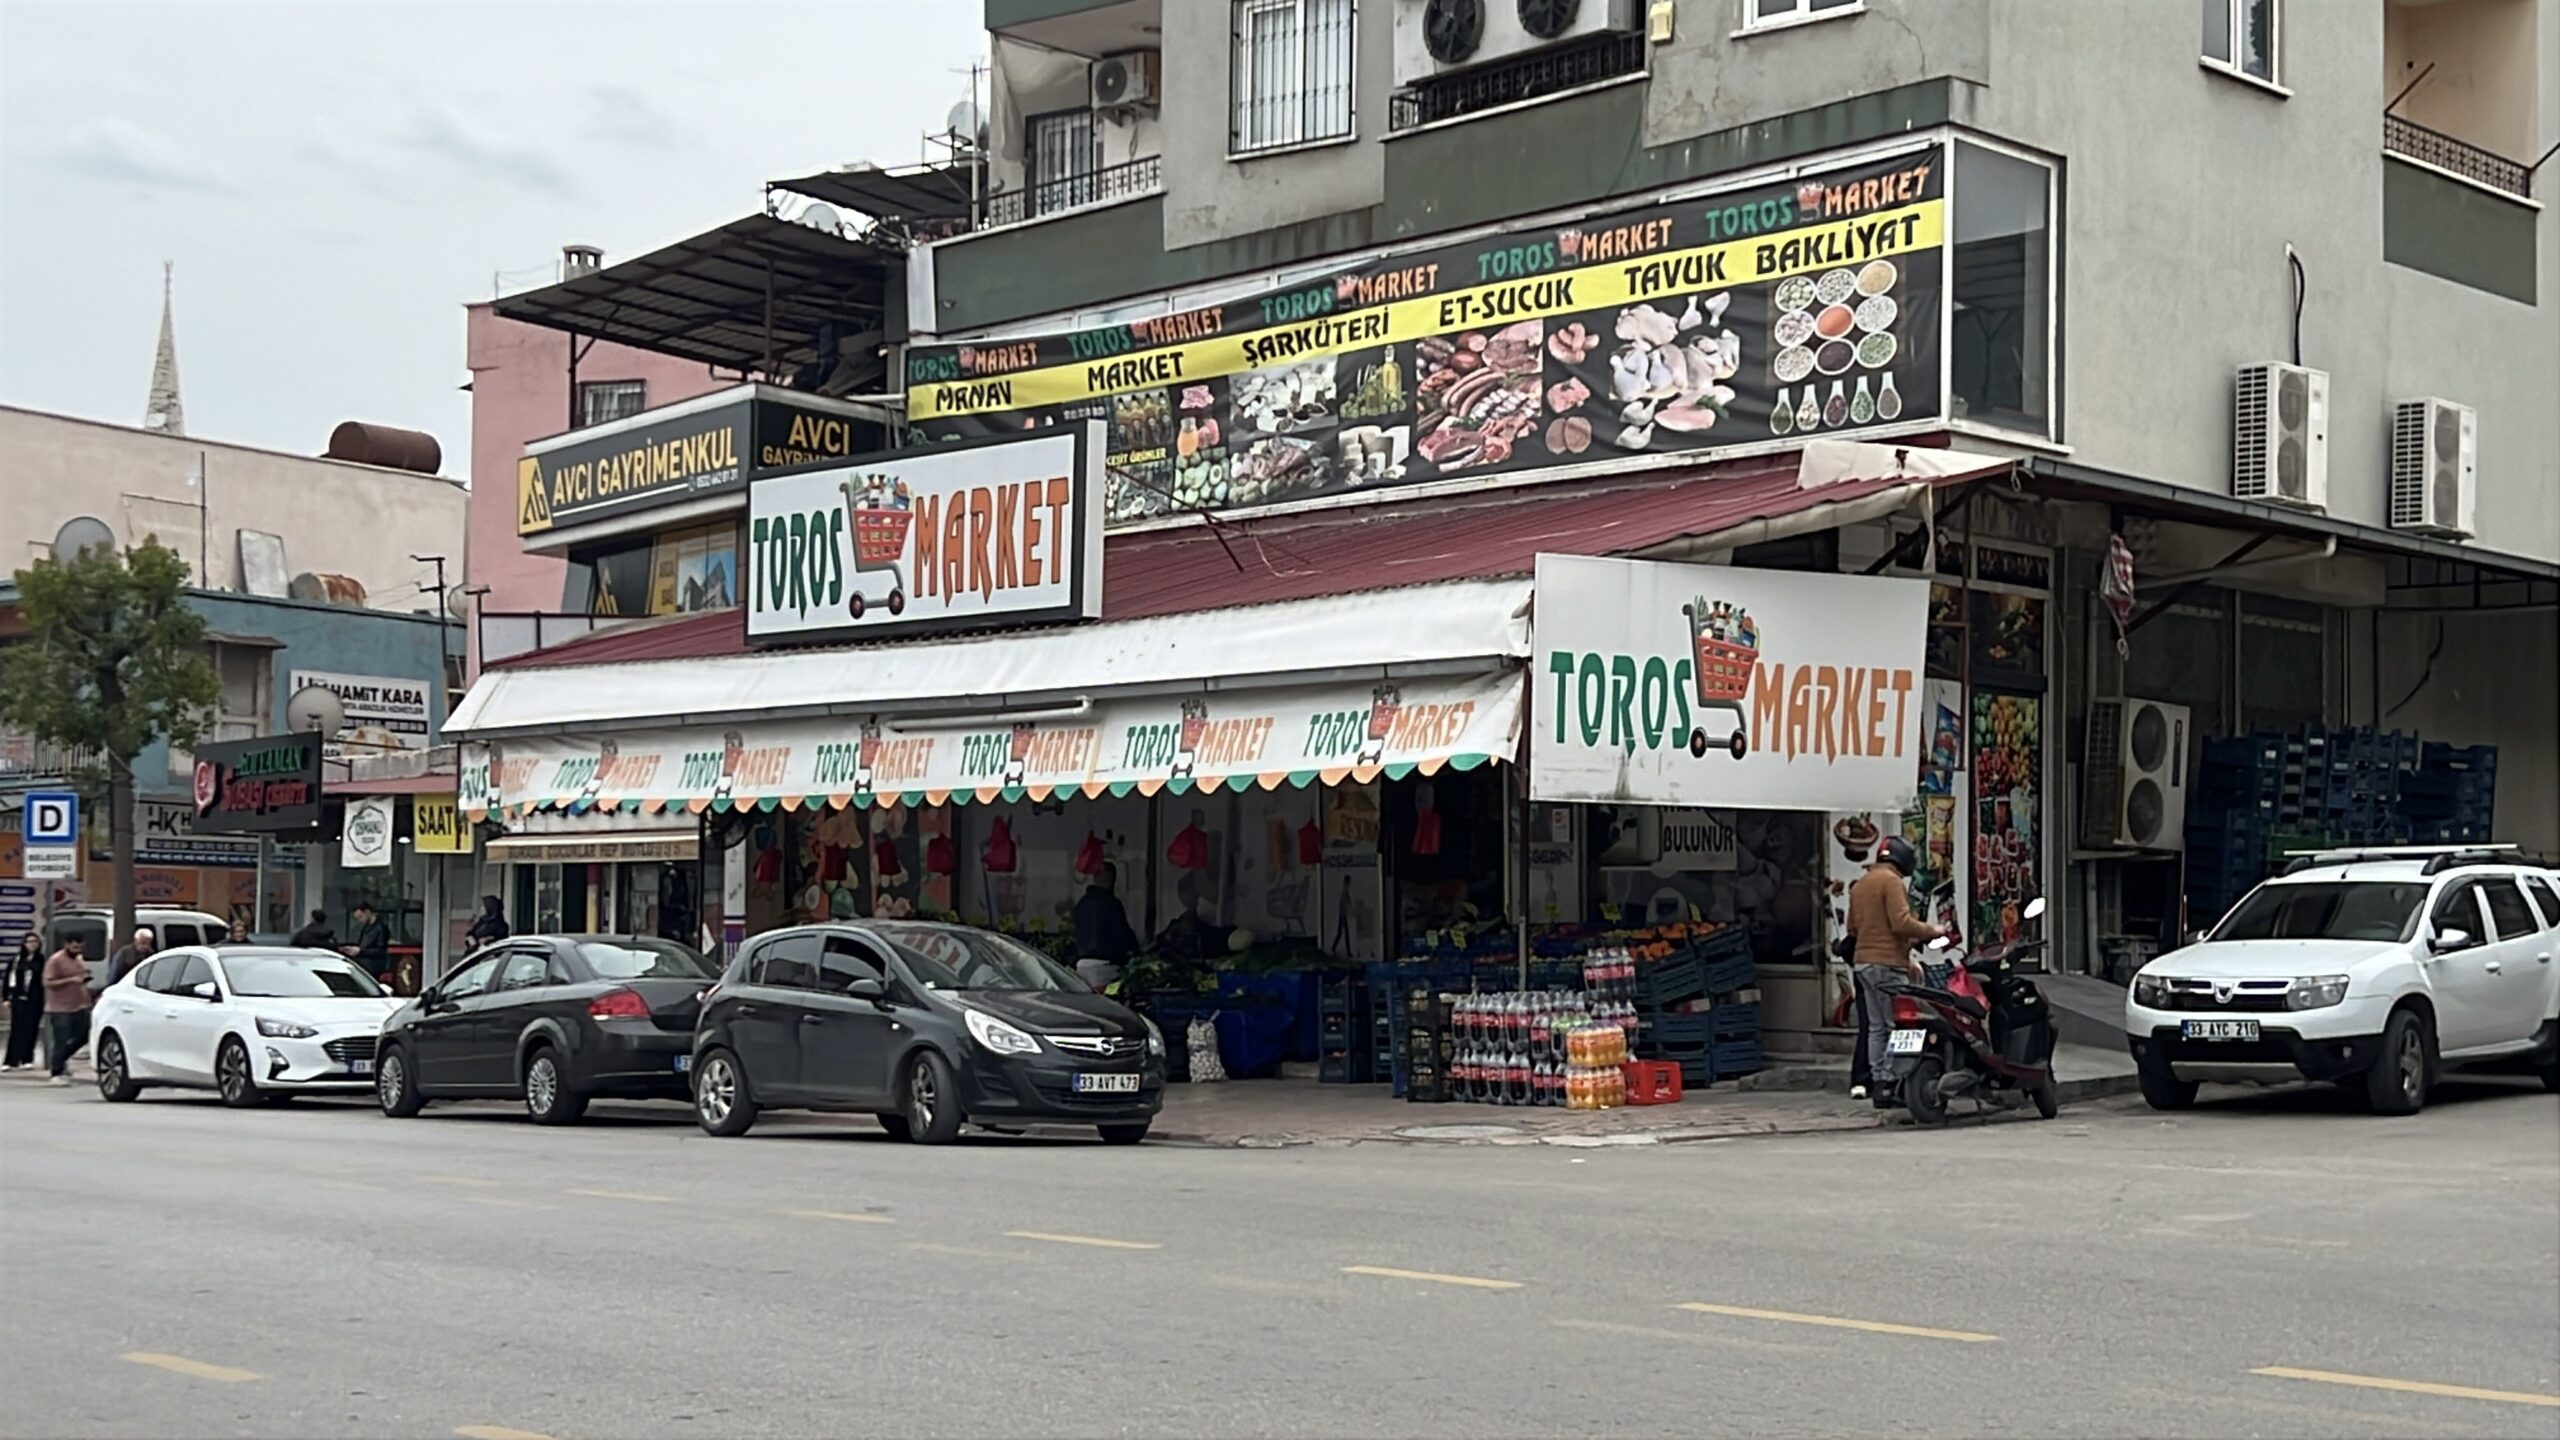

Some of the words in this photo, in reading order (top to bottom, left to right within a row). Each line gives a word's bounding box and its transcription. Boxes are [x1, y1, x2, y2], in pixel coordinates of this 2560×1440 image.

[975, 342, 1038, 376] MARKET
[1068, 328, 1132, 359] TOROS
[1149, 308, 1223, 344] MARKET
[1260, 287, 1333, 323] TOROS
[1357, 264, 1438, 304] MARKET
[1478, 242, 1554, 280] TOROS
[1582, 218, 1672, 262] MARKET
[1705, 196, 1793, 239] TOROS
[1825, 165, 1929, 217] MARKET
[935, 380, 1012, 412] MANAV
[1088, 352, 1184, 392] MARKET
[1242, 306, 1389, 368] ŞARKÜTERİ
[1439, 278, 1574, 327] ET-SUCUK
[1625, 251, 1726, 296] TAVUK
[1757, 214, 1921, 275] BAKLİYAT
[787, 414, 850, 455] AVCI
[553, 462, 592, 507] AVCI
[596, 427, 738, 497] GAYRİMENKUL
[752, 507, 843, 620] TOROS
[914, 478, 1069, 607] MARKET
[382, 688, 424, 705] KARA
[1550, 651, 1692, 758] TOROS
[1752, 662, 1912, 766] MARKET
[550, 758, 600, 790] TOROS
[678, 752, 723, 789] TOROS
[734, 747, 791, 790] MARKET
[813, 743, 859, 787] TOROS
[873, 738, 935, 783] MARKET
[960, 733, 1011, 779] TOROS
[1027, 728, 1095, 775] MARKET
[1122, 723, 1180, 771] TOROS
[1198, 717, 1274, 769] MARKET
[1303, 709, 1370, 763] TOROS
[1386, 700, 1475, 755] MARKET
[40, 804, 62, 832] D
[1663, 825, 1734, 852] BULUNUR
[2190, 1022, 2202, 1036] 33
[2209, 1022, 2229, 1036] AYC
[1080, 1076, 1094, 1089] 33
[1098, 1076, 1116, 1090] AVT
[1120, 1076, 1138, 1090] 473
